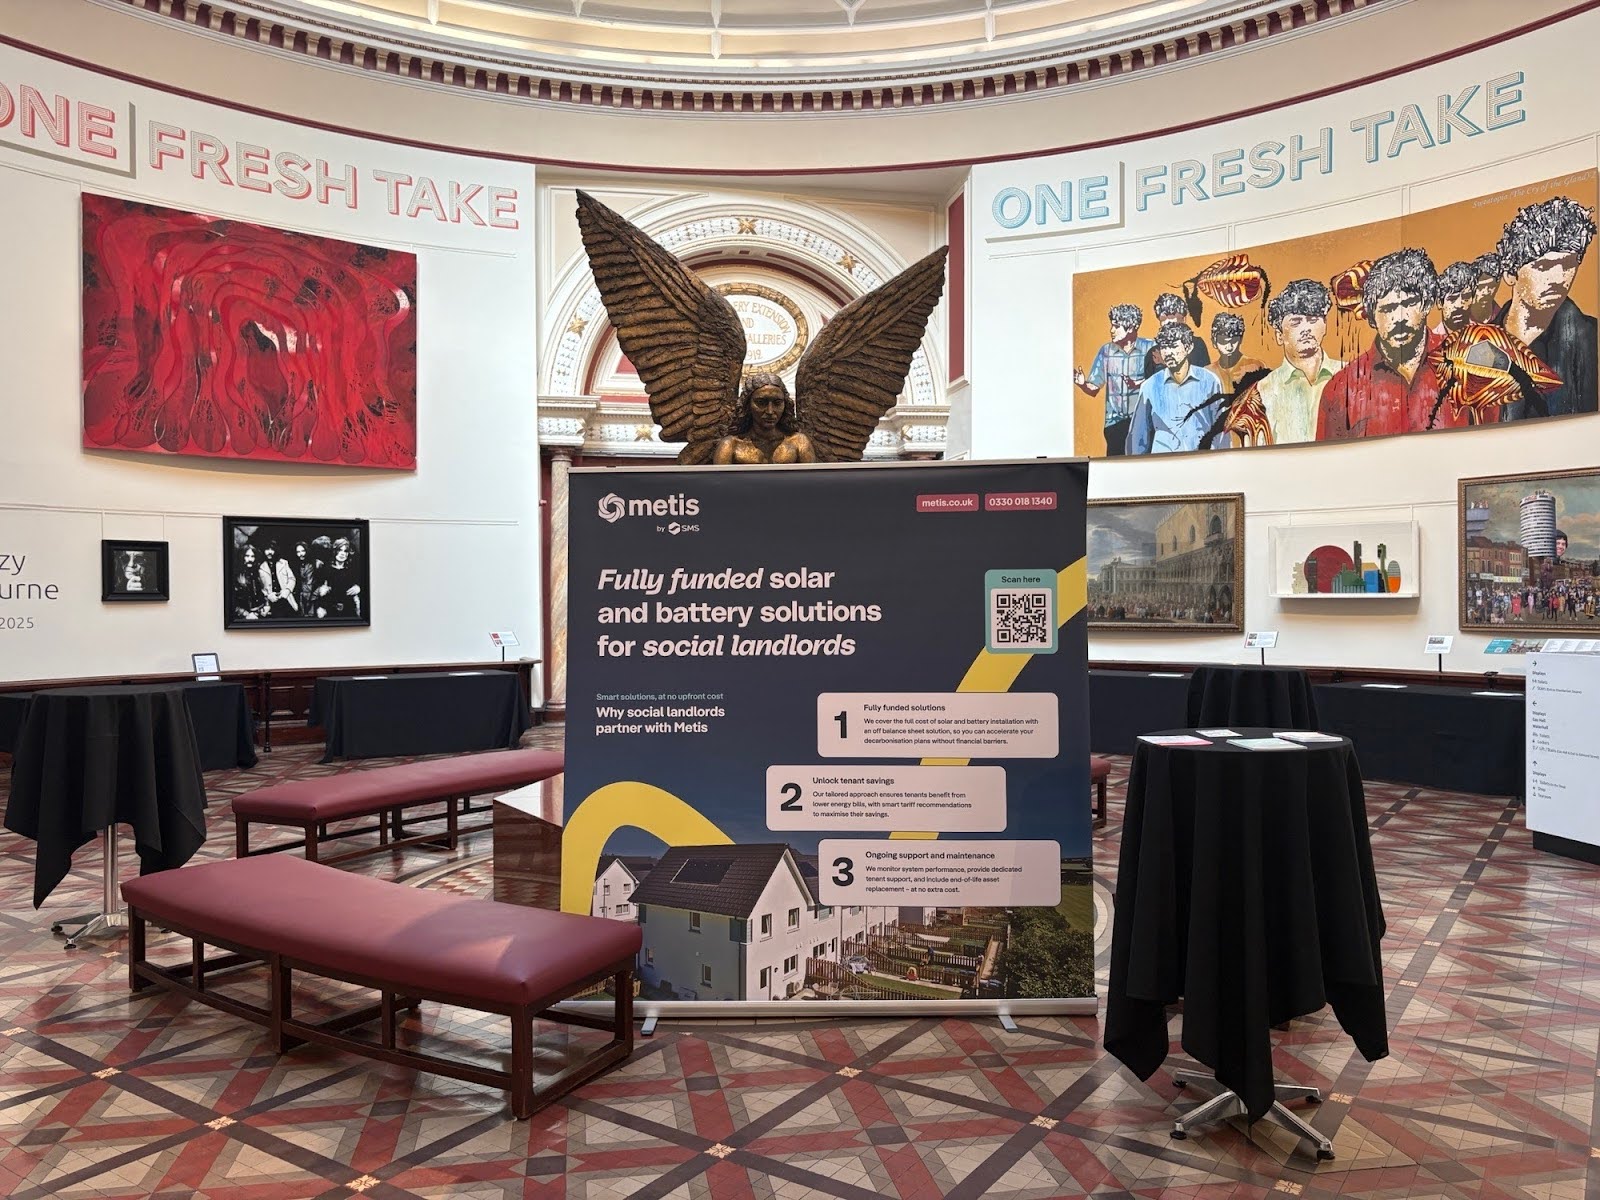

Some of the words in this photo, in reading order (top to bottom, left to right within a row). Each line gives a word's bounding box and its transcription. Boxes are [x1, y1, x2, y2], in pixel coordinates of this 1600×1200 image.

[991, 174, 1110, 230] ONE
[1135, 126, 1334, 212] FRESH
[1350, 70, 1526, 163] TAKE
[148, 120, 358, 209] FRESH
[372, 169, 520, 230] TAKE
[1526, 184, 1539, 195] Cry
[1540, 181, 1550, 192] of
[1550, 178, 1561, 188] the
[734, 300, 750, 312] ERY
[752, 302, 791, 334] EXTENSION
[742, 318, 754, 328] ND
[744, 334, 787, 346] ALLERIES
[746, 349, 763, 360] 912
[628, 493, 700, 516] metis
[922, 498, 973, 507] metis.co.uk
[989, 498, 1013, 506] 0330
[1014, 497, 1030, 506] 018
[1032, 497, 1053, 506] 1340
[0, 554, 26, 576] zy
[598, 568, 664, 596] Fully
[668, 568, 764, 595] funded
[769, 566, 836, 589] solar
[0, 584, 58, 600] urne
[598, 602, 648, 624] and
[656, 602, 753, 628] battery
[760, 600, 882, 622] solutions
[597, 634, 636, 657] for
[642, 634, 725, 657] social
[730, 634, 856, 656] landlords
[620, 693, 657, 701] solutions,
[678, 693, 706, 701] upfront
[596, 706, 625, 720] Why
[627, 706, 664, 718] social
[666, 706, 725, 718] landlords
[864, 704, 881, 712] Fully
[596, 723, 642, 736] partner
[645, 722, 672, 733] with
[674, 722, 708, 733] Metis
[834, 710, 847, 738] 1
[866, 778, 894, 786] savings
[781, 783, 802, 811] 2
[866, 851, 898, 860] Ongoing
[832, 857, 854, 886] 3
